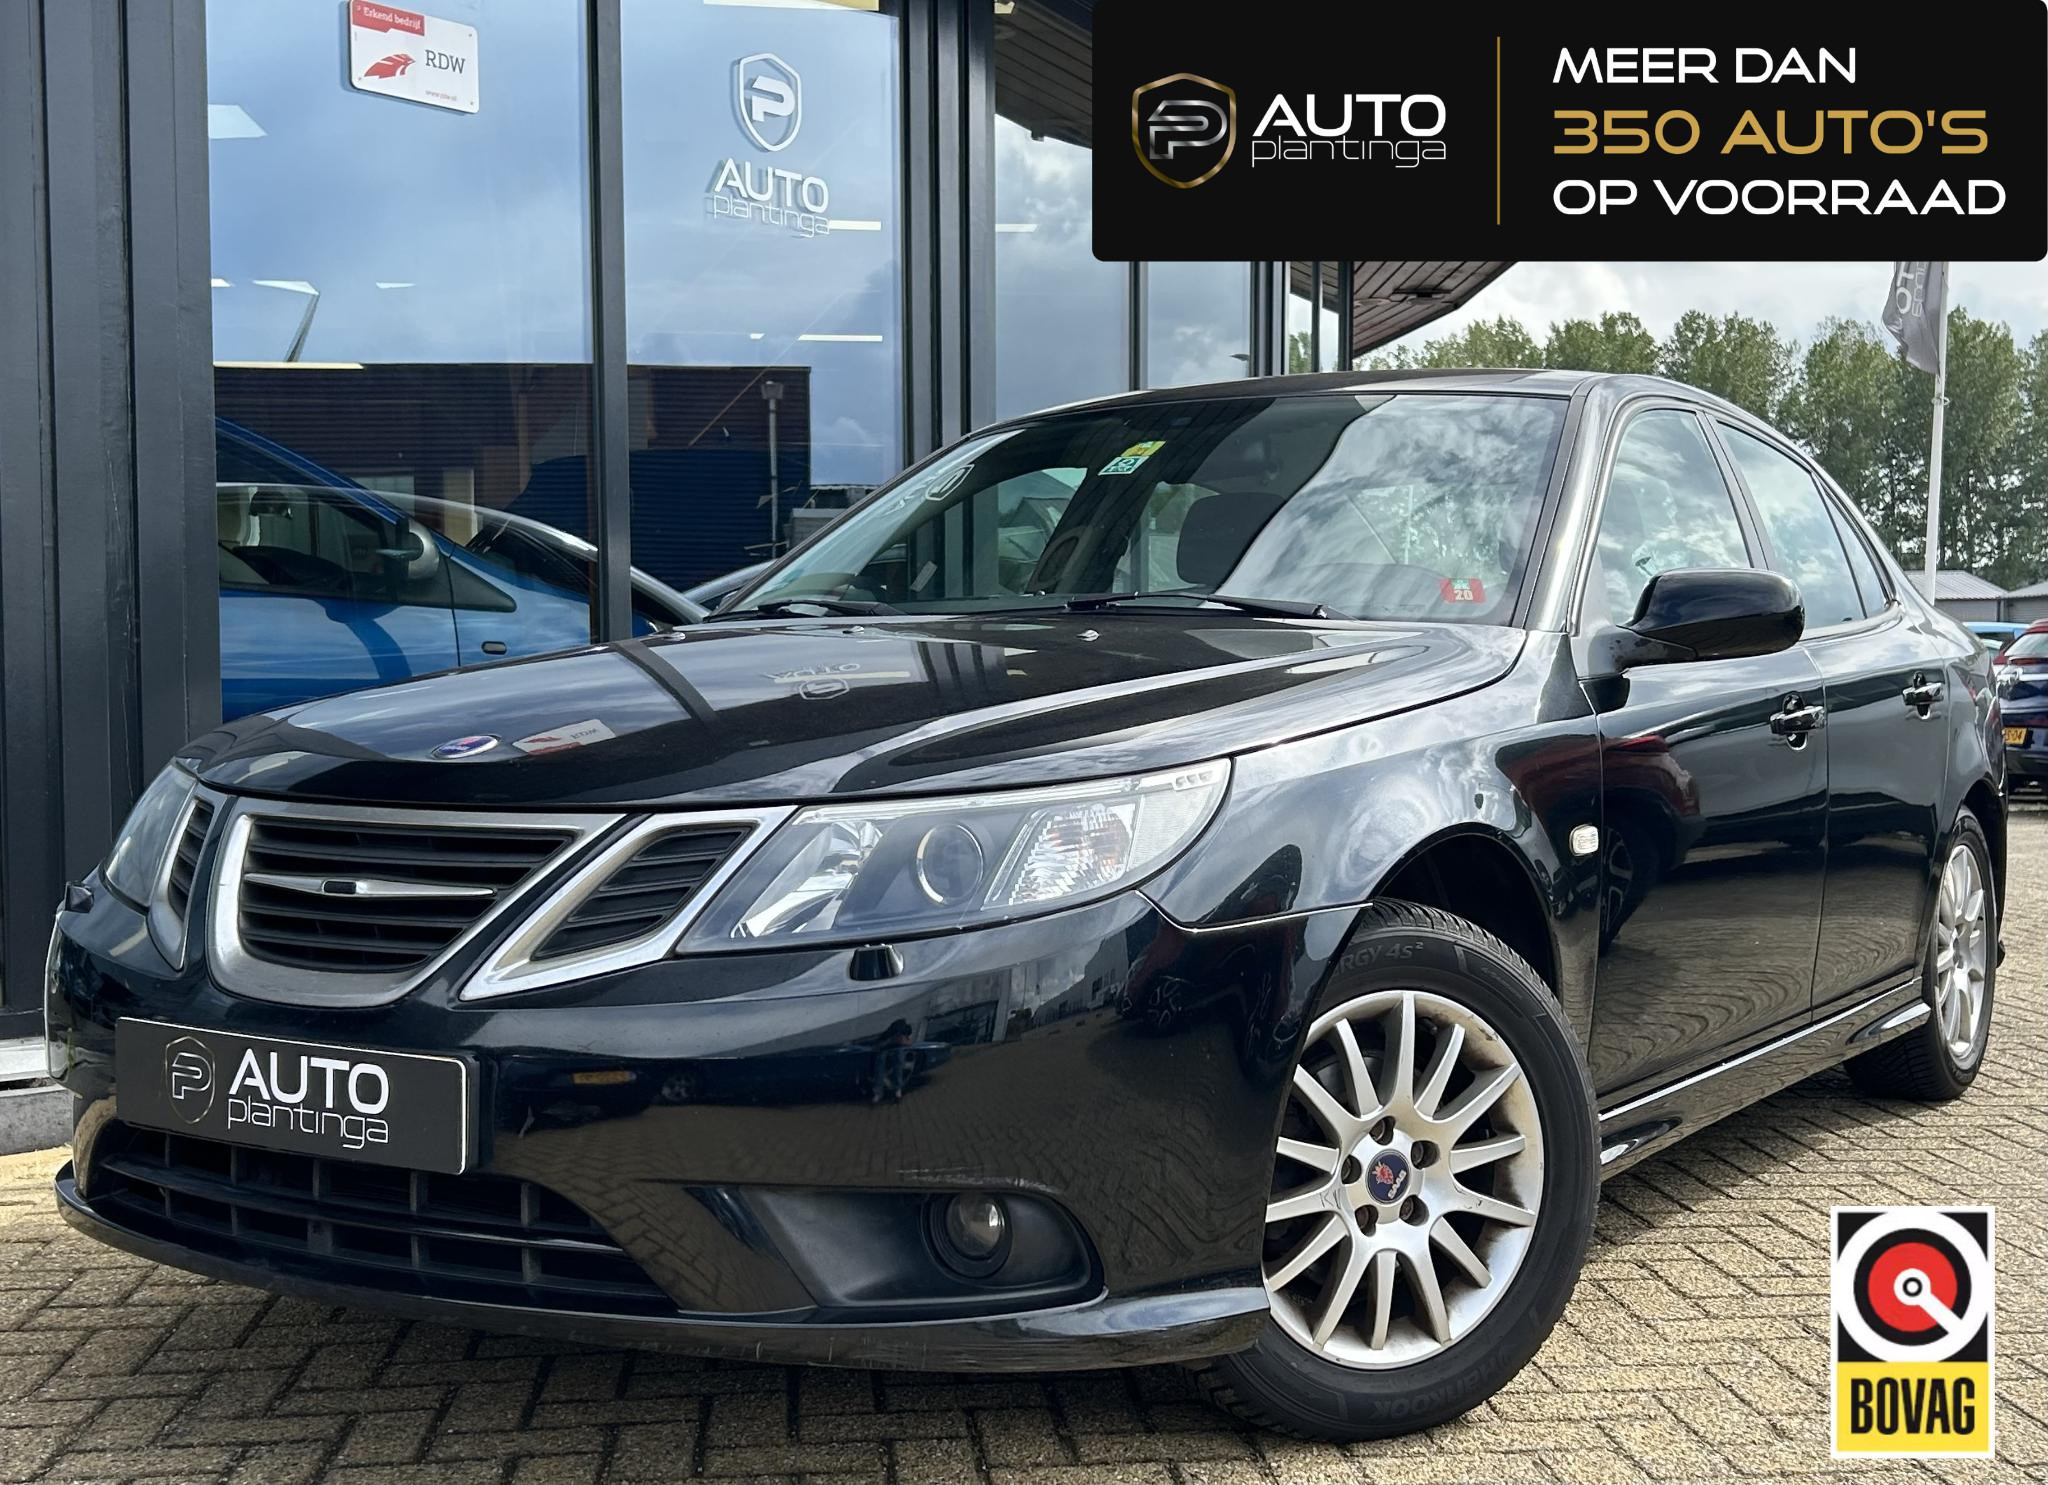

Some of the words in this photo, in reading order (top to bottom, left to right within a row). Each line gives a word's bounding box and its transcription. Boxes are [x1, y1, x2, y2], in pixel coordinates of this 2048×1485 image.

[363, 7, 393, 23] Erkend
[394, 14, 421, 30] bedrijf
[425, 49, 466, 74] RDW
[714, 157, 829, 214] AUTO
[713, 193, 830, 238] plantinga
[1454, 589, 1474, 601] 20
[229, 1048, 389, 1115] AUTO
[228, 1095, 389, 1149] plantinga
[1387, 1169, 1407, 1199] SAAB
